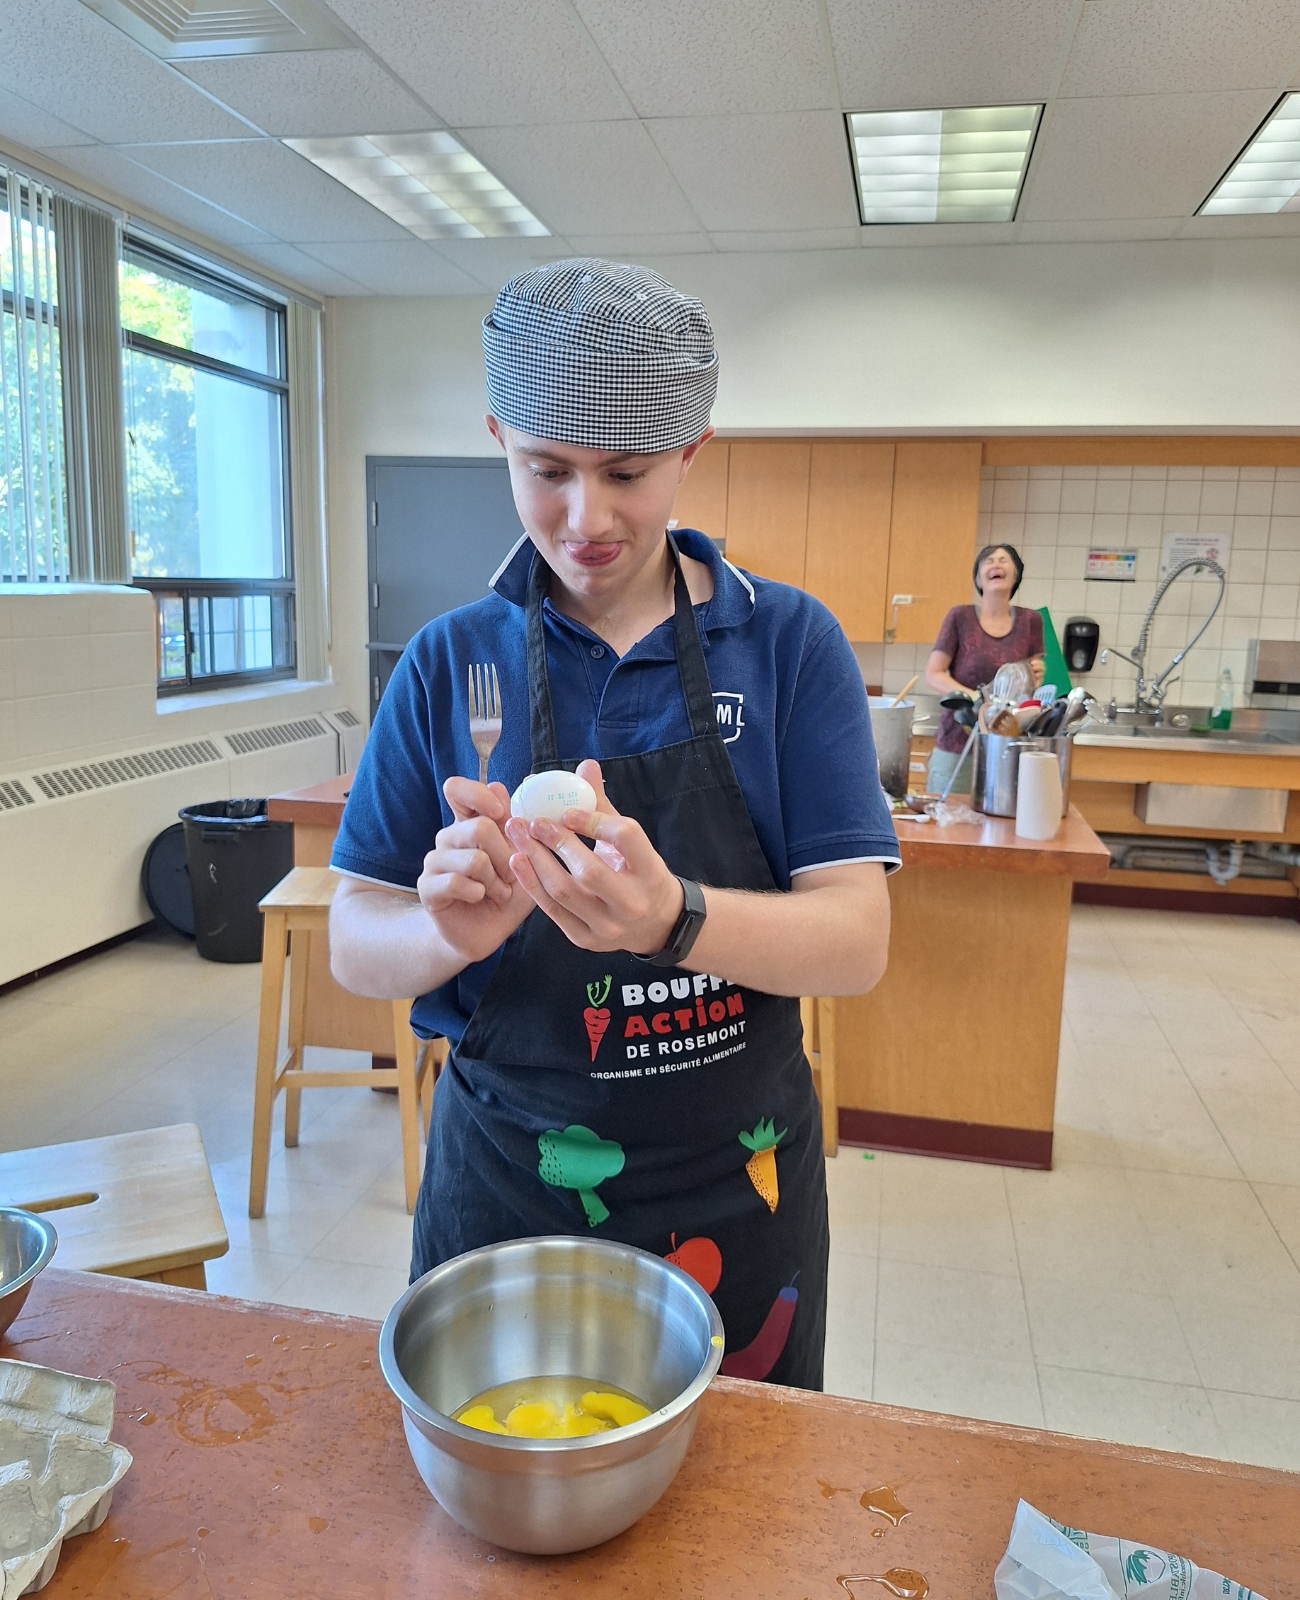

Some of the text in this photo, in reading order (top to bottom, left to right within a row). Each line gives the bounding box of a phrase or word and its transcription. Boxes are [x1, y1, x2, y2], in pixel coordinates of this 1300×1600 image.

[621, 974, 738, 1006] BOUFF
[627, 1021, 746, 1059] DE ROSEMONT
[590, 1042, 747, 1080] ORGANISME EN SÉCURITÉ ALIMENTAIRE
